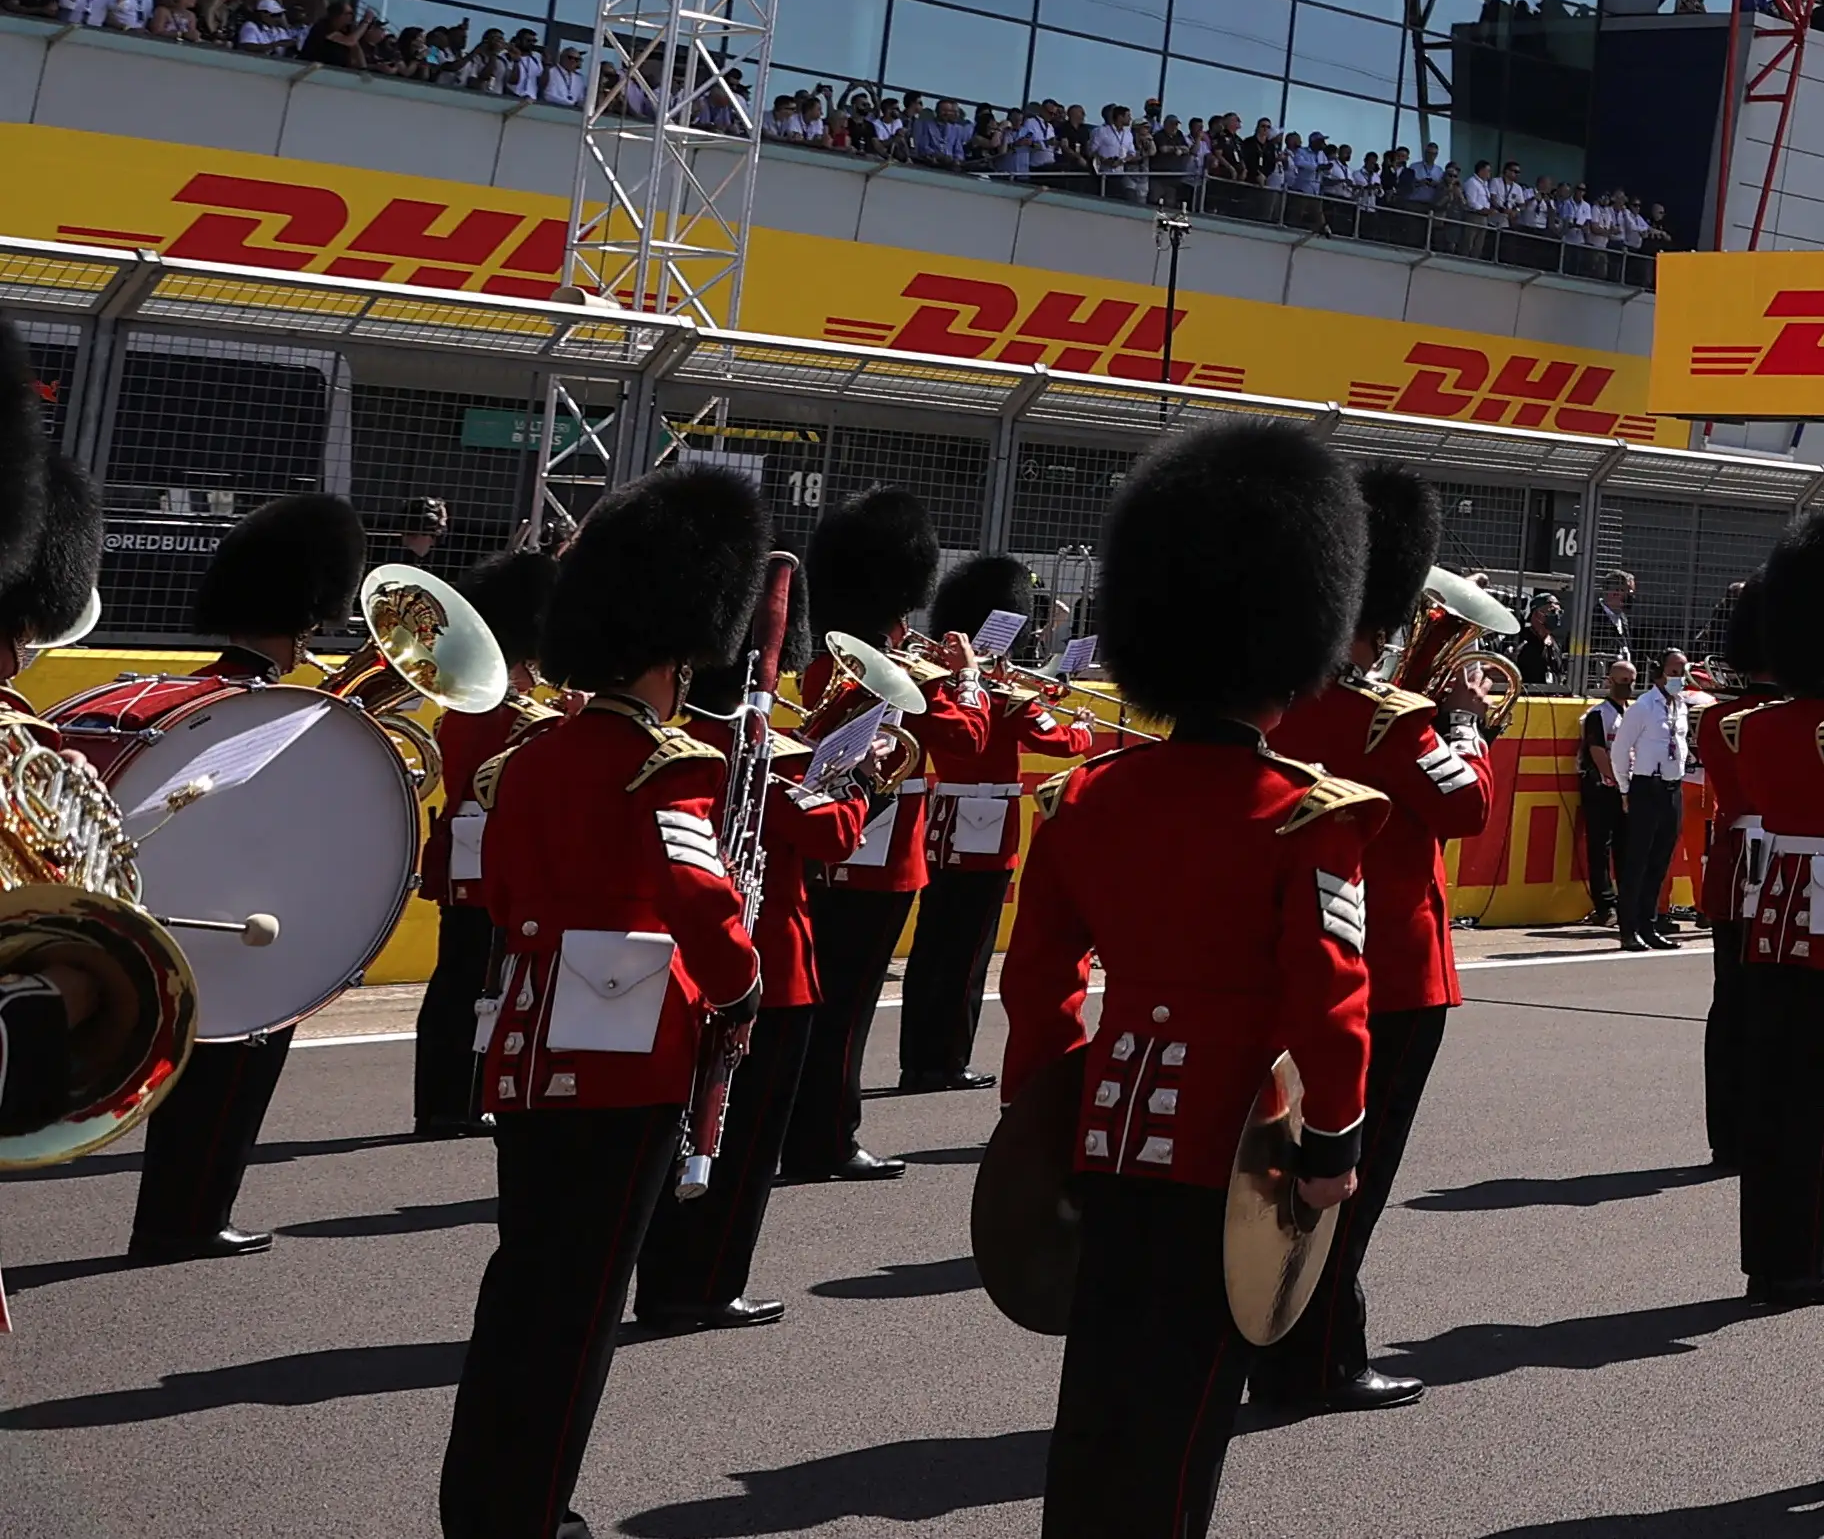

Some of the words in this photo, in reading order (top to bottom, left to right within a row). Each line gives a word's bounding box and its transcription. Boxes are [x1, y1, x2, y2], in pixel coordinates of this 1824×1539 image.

[161, 172, 612, 297] DHL
[888, 273, 1197, 386] DHL
[1394, 343, 1619, 434] DHL
[788, 471, 822, 508] 18
[1556, 527, 1578, 557] 16
